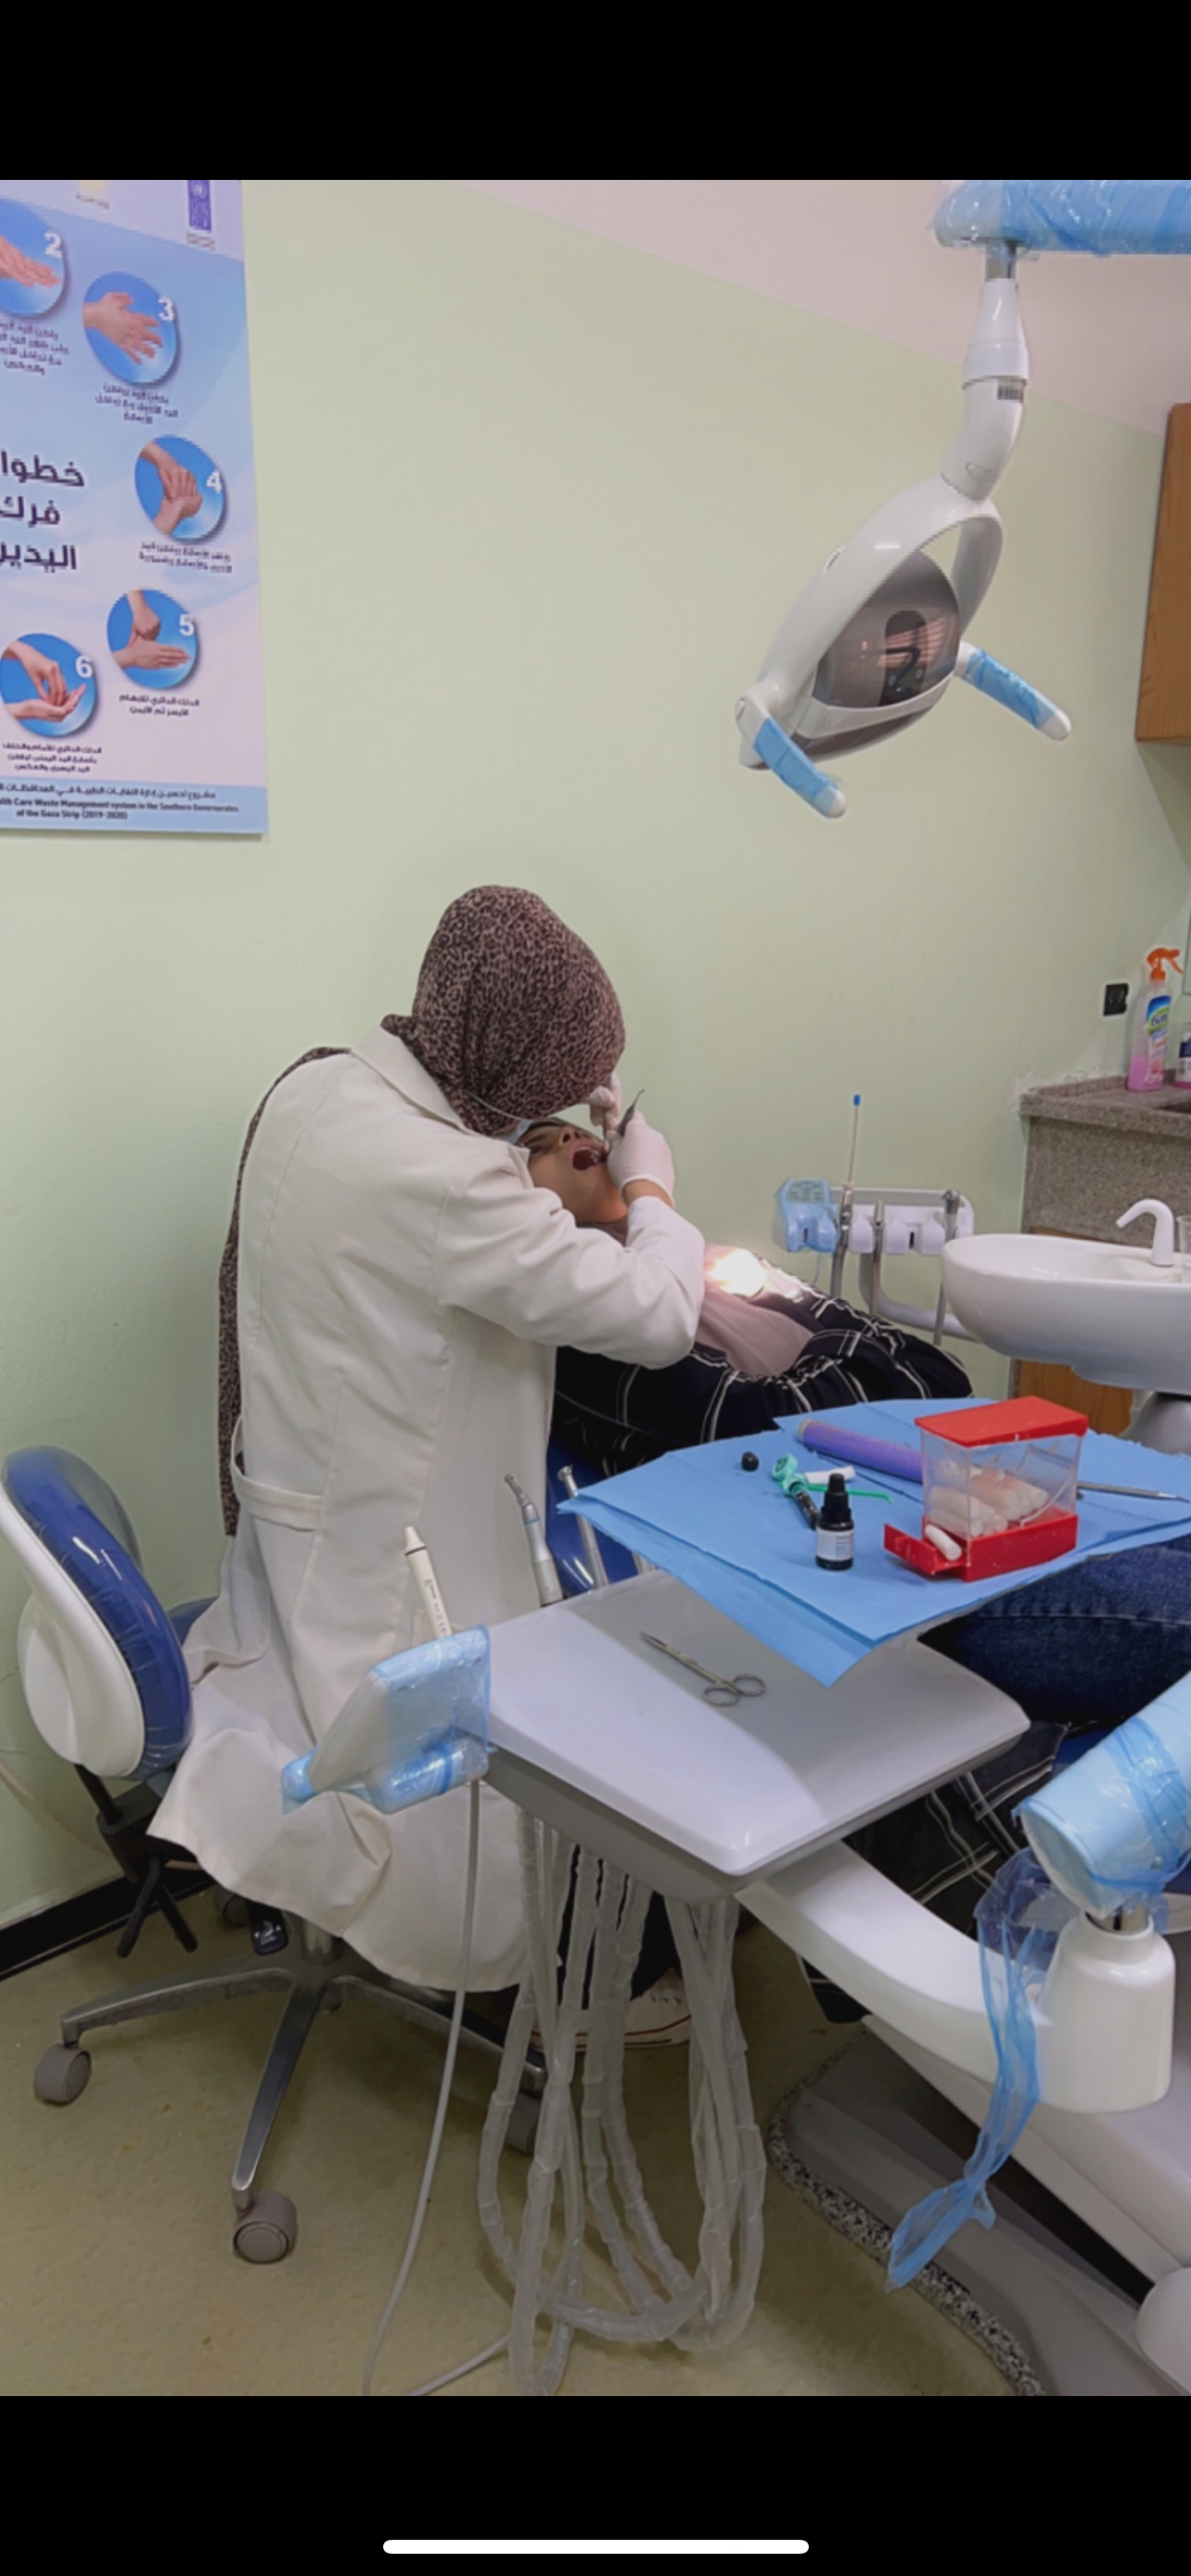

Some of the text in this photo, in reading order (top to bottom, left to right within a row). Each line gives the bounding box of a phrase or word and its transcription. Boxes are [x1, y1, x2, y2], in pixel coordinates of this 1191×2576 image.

[45, 233, 62, 257] 2
[159, 297, 174, 321] 3
[207, 470, 224, 493] 4
[179, 614, 195, 636] 5
[75, 655, 93, 678] 6
[14, 798, 32, 807] Care
[33, 799, 58, 808] Waste
[59, 800, 109, 810] Management
[109, 802, 135, 811] system
[147, 803, 159, 811] the
[159, 803, 191, 812] Southern
[61, 811, 80, 821] Strip
